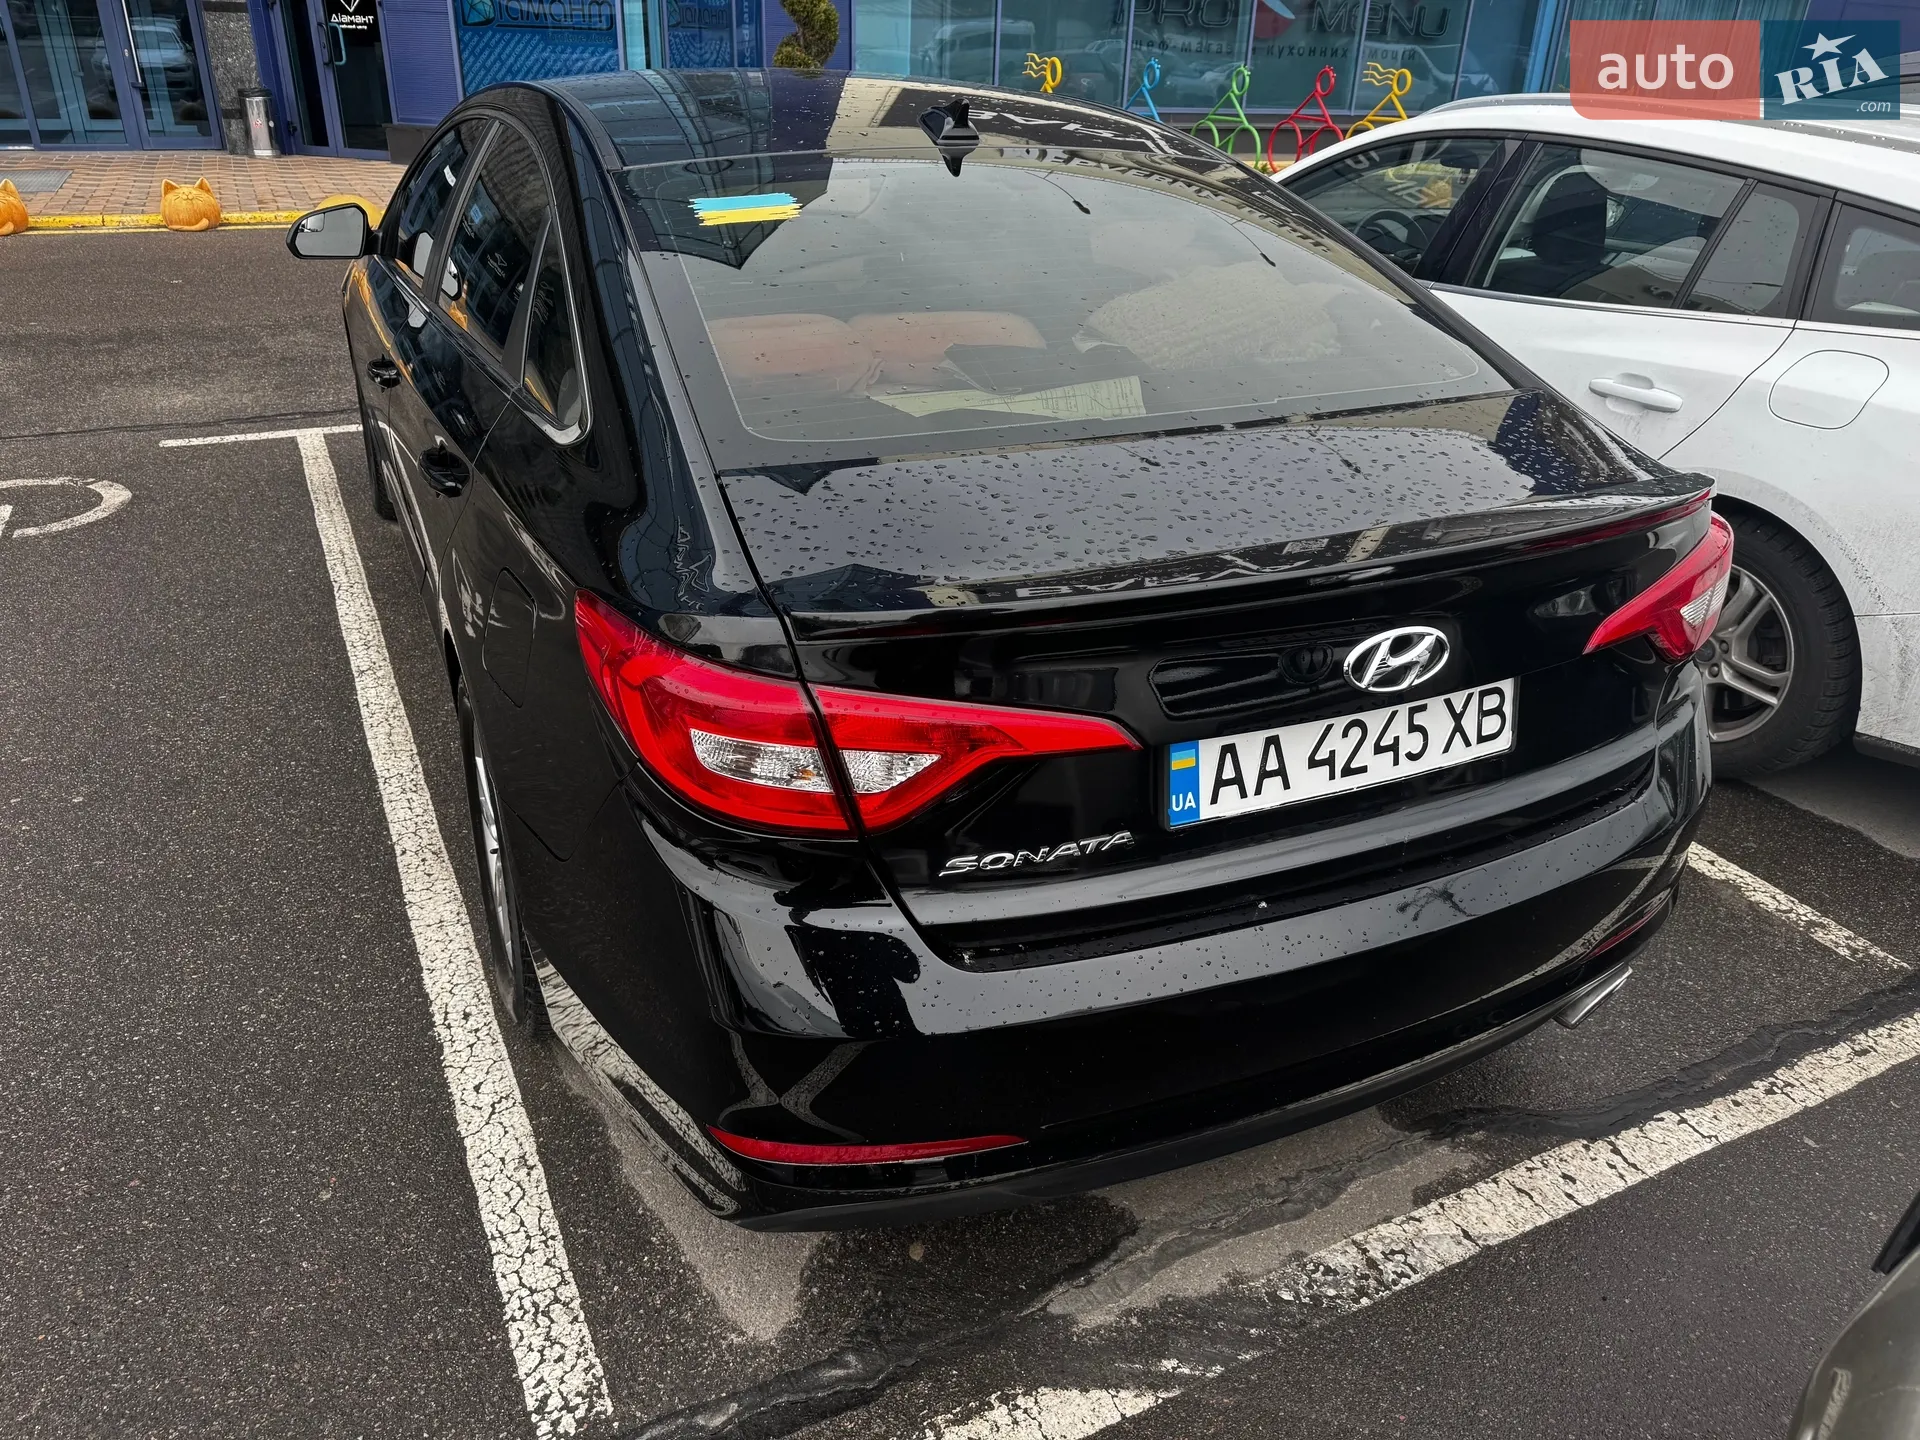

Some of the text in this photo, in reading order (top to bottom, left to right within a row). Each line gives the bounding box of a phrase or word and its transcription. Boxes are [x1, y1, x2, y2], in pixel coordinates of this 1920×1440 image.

[1210, 687, 1506, 805] AA 4245 XB
[1171, 792, 1196, 812] UA
[938, 830, 1135, 877] SONATA
